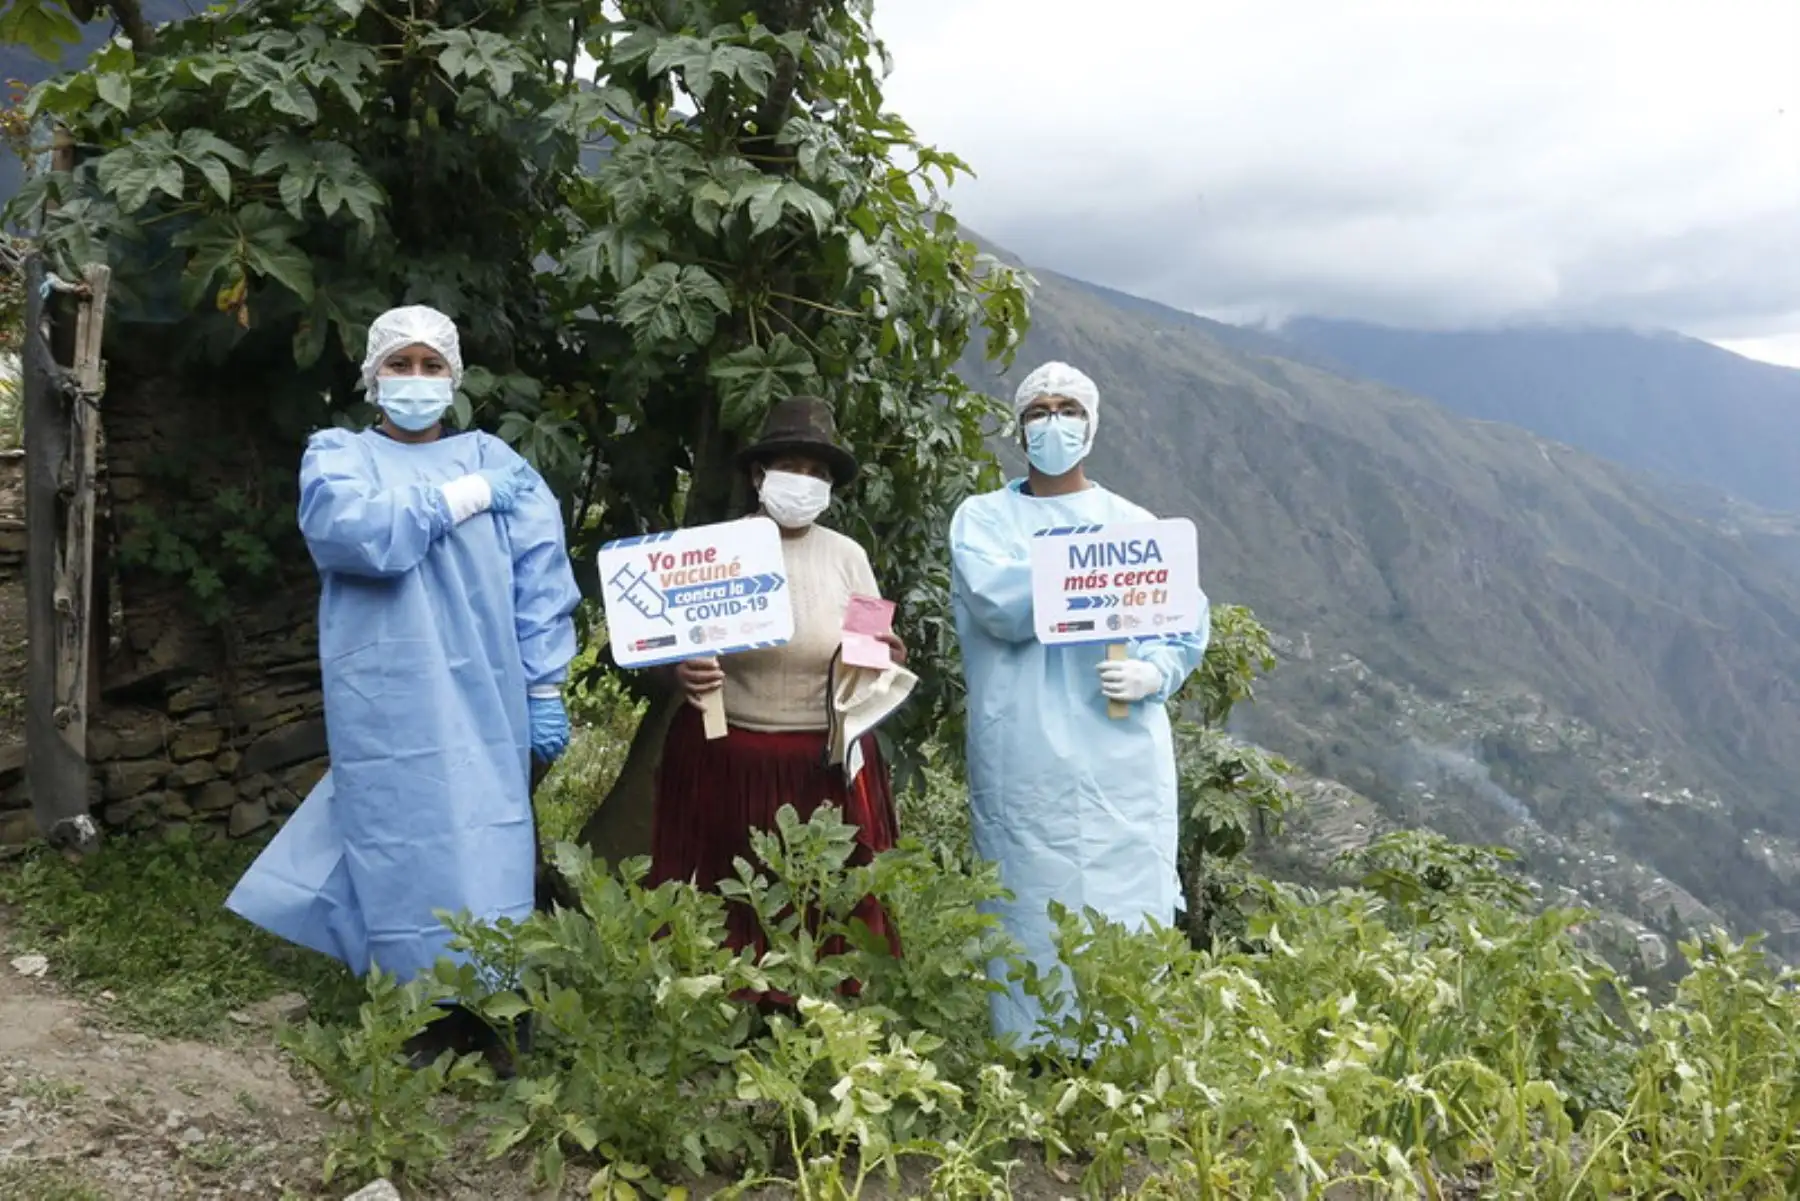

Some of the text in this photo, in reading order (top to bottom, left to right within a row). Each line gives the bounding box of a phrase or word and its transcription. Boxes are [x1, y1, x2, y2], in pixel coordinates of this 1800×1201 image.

[647, 547, 718, 572] Yo me
[1068, 538, 1163, 569] MINSA
[660, 556, 741, 588] vacuné
[1064, 569, 1169, 591] más cerca
[675, 583, 745, 603] contra la
[1122, 588, 1168, 606] de ti
[685, 596, 769, 622] COVID-19
